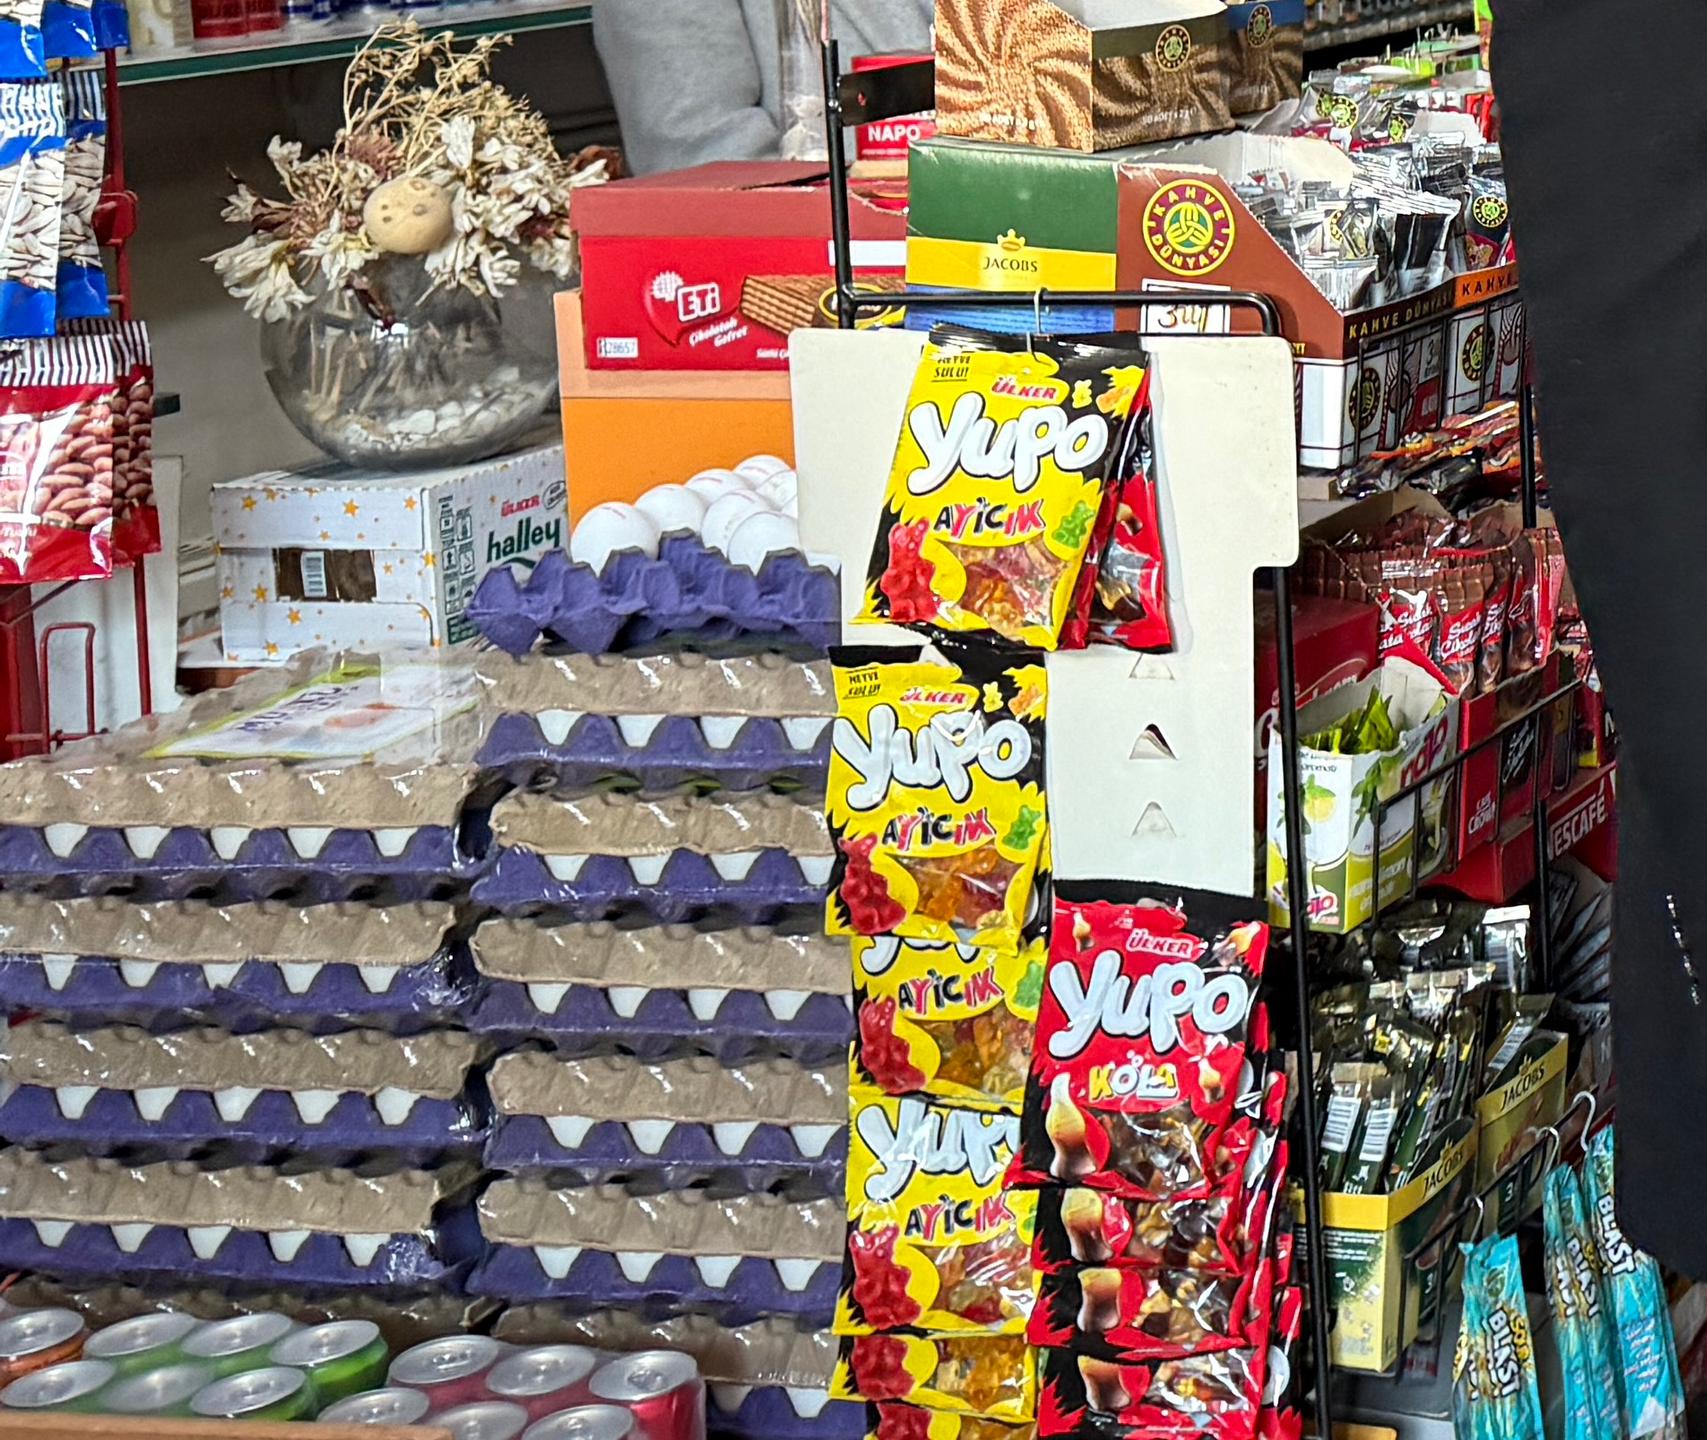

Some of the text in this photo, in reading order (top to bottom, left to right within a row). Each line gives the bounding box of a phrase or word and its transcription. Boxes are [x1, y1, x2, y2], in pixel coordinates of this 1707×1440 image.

[1151, 184, 1226, 223] KAHVE
[983, 256, 1039, 274] JACOBS
[1149, 230, 1224, 270] DÜNYASI
[712, 325, 749, 348] Gofret
[1349, 313, 1400, 340] KAHVE
[991, 375, 1059, 401] ÜLKER
[906, 390, 1110, 497] Yupo
[501, 495, 541, 518] ÜLKER
[486, 517, 562, 564] halley
[899, 687, 967, 705] ÜLKER
[832, 703, 1034, 812] Yupo
[1126, 928, 1195, 958] ÜLKER
[1047, 948, 1251, 1061] Yupo
[1088, 1063, 1181, 1103] KOLA
[1500, 1063, 1546, 1111] JACOBS
[856, 1097, 1022, 1201] Yup
[1597, 1193, 1637, 1276] BLAST
[1487, 1308, 1522, 1399] BLAST
